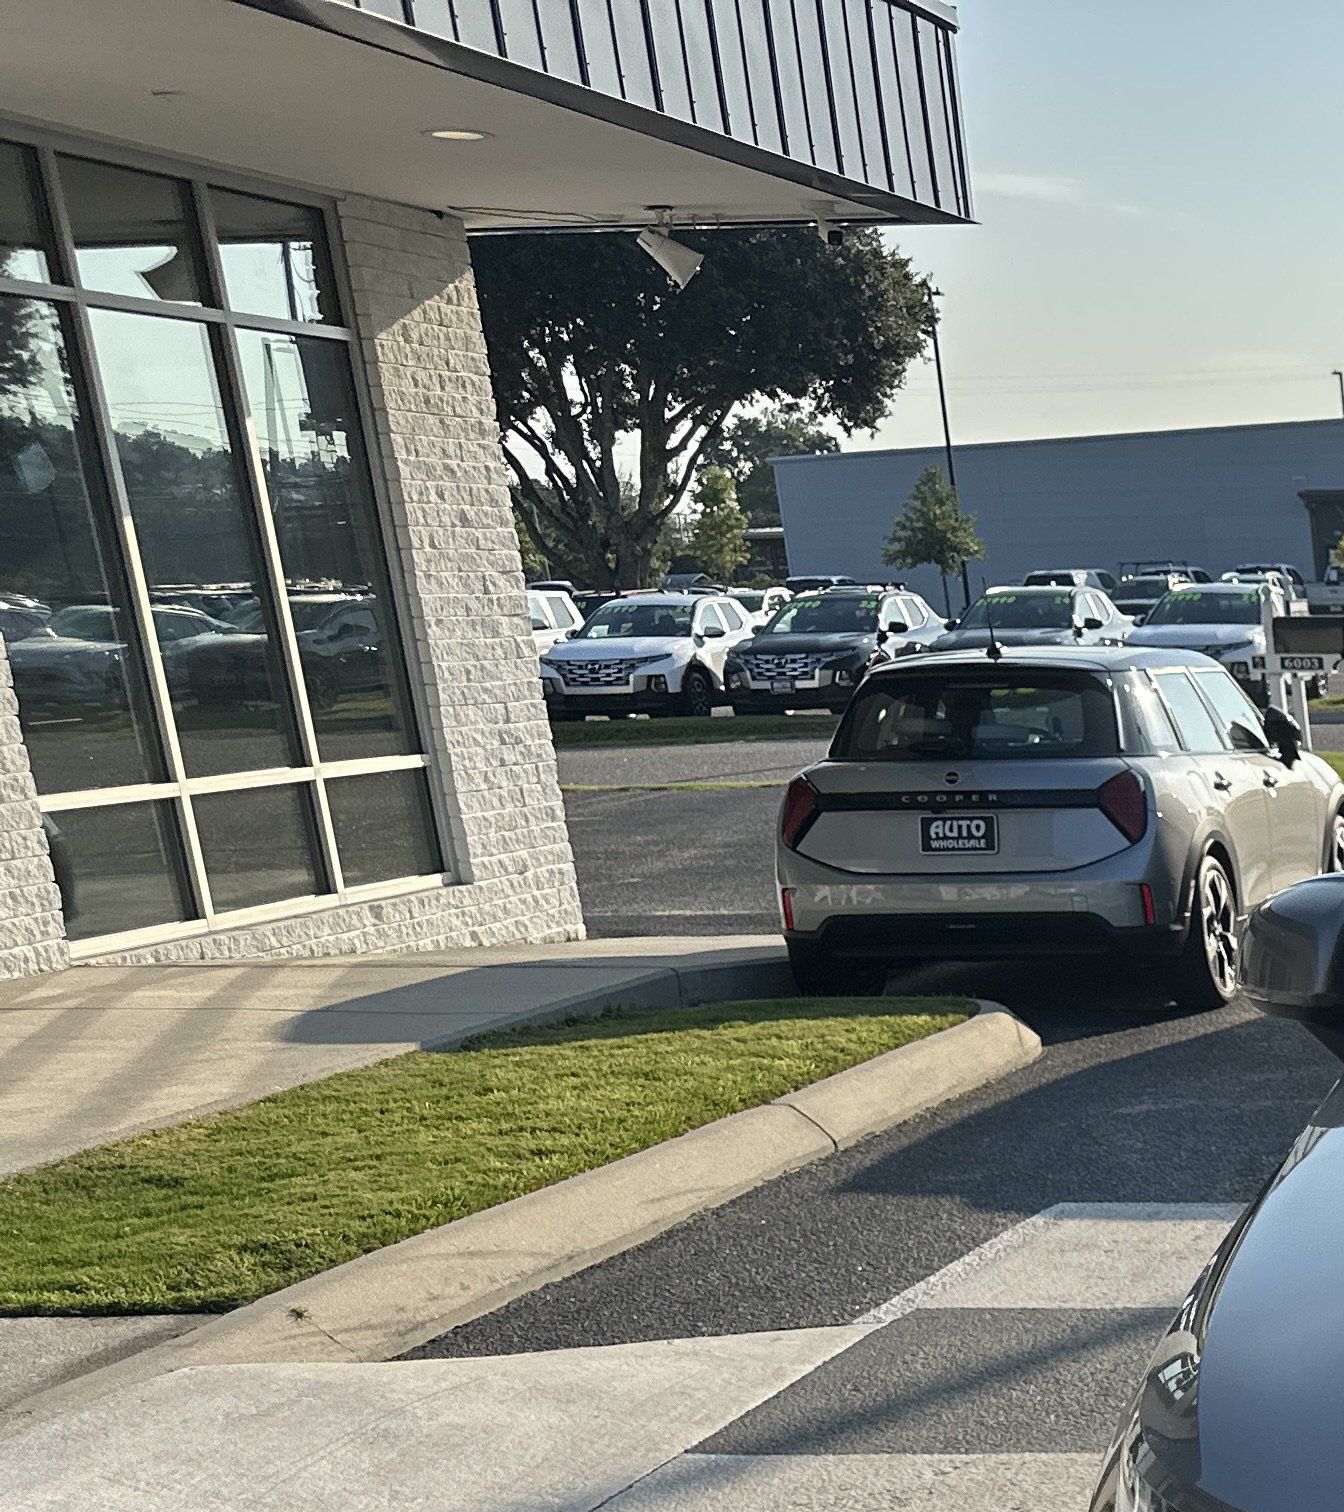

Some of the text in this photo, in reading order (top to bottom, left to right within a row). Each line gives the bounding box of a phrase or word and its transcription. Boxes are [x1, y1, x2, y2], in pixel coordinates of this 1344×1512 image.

[1283, 657, 1320, 670] 6003
[901, 793, 999, 804] COOPER
[929, 819, 986, 839] AUTO
[930, 838, 987, 849] WHOLESALE
